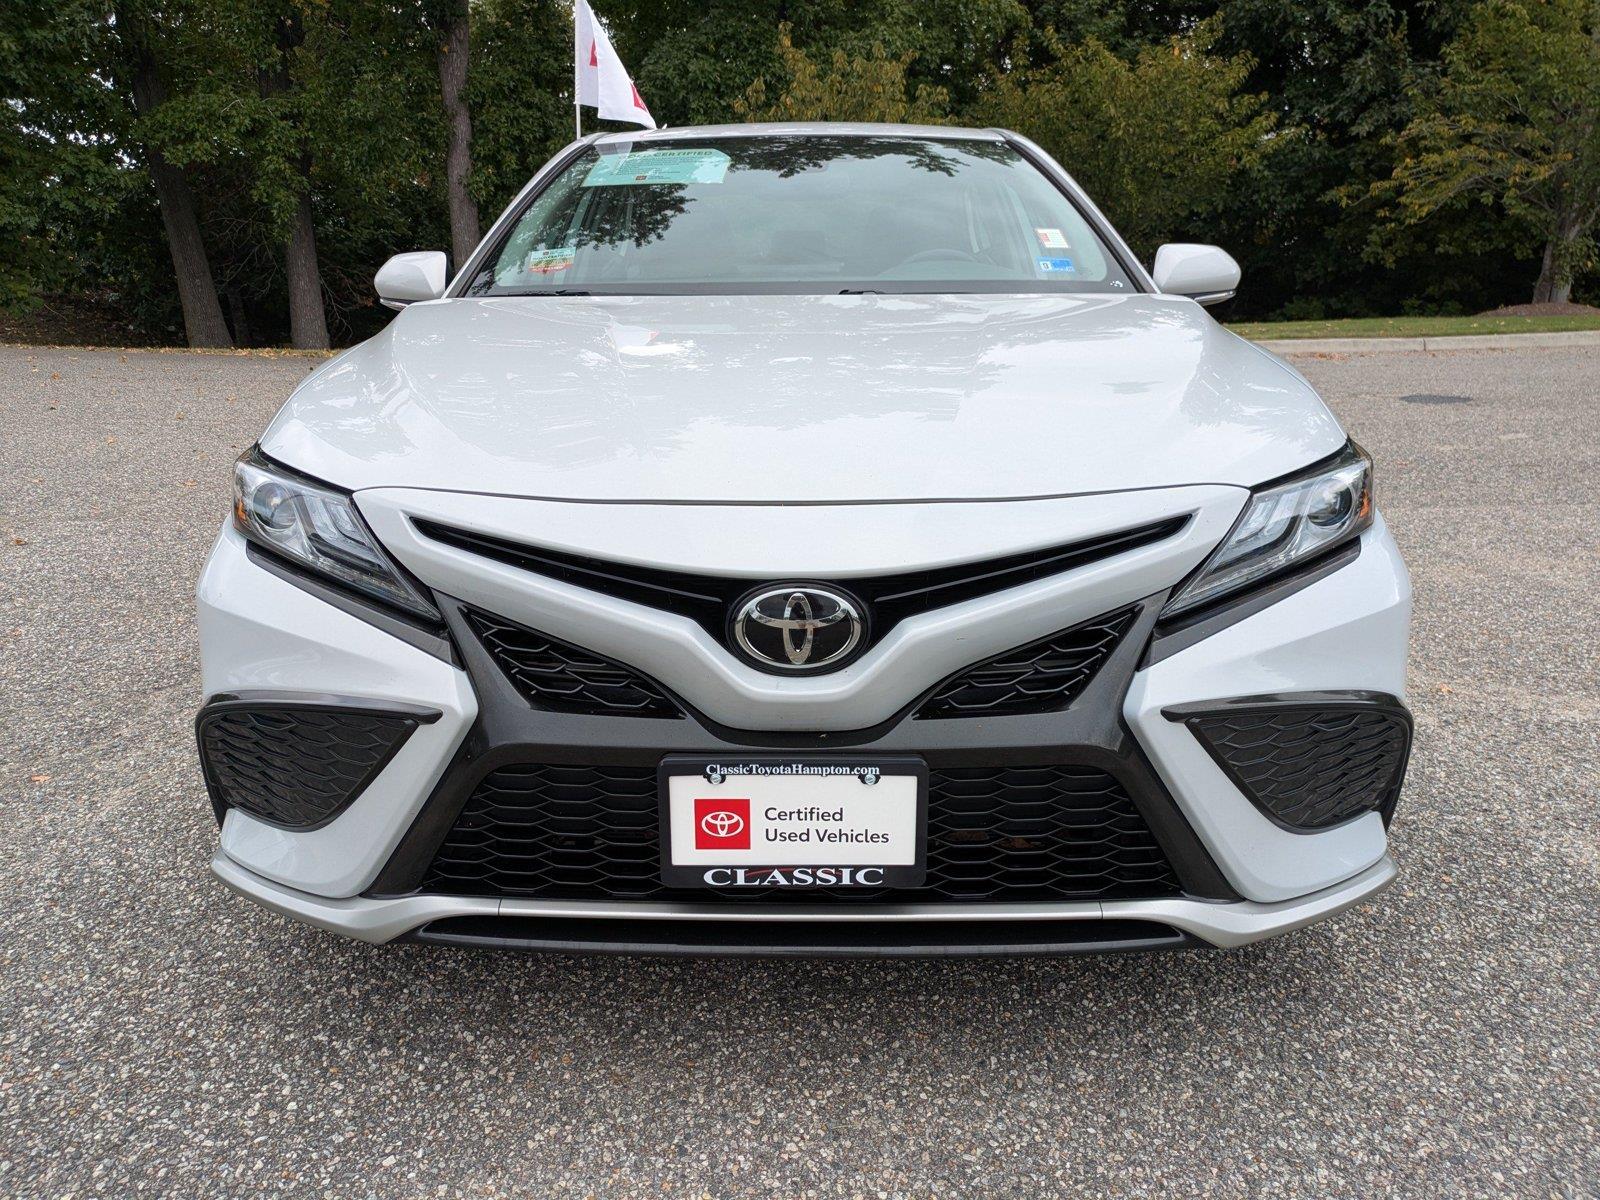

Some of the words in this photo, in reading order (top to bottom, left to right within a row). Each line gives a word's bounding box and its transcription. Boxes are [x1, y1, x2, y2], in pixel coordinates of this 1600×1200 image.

[705, 763, 880, 777] ClassicToyotaHampton.com
[764, 806, 844, 822] Certified
[765, 827, 810, 843] Used
[815, 828, 890, 844] Vehicles
[703, 867, 884, 886] CLASSIC
